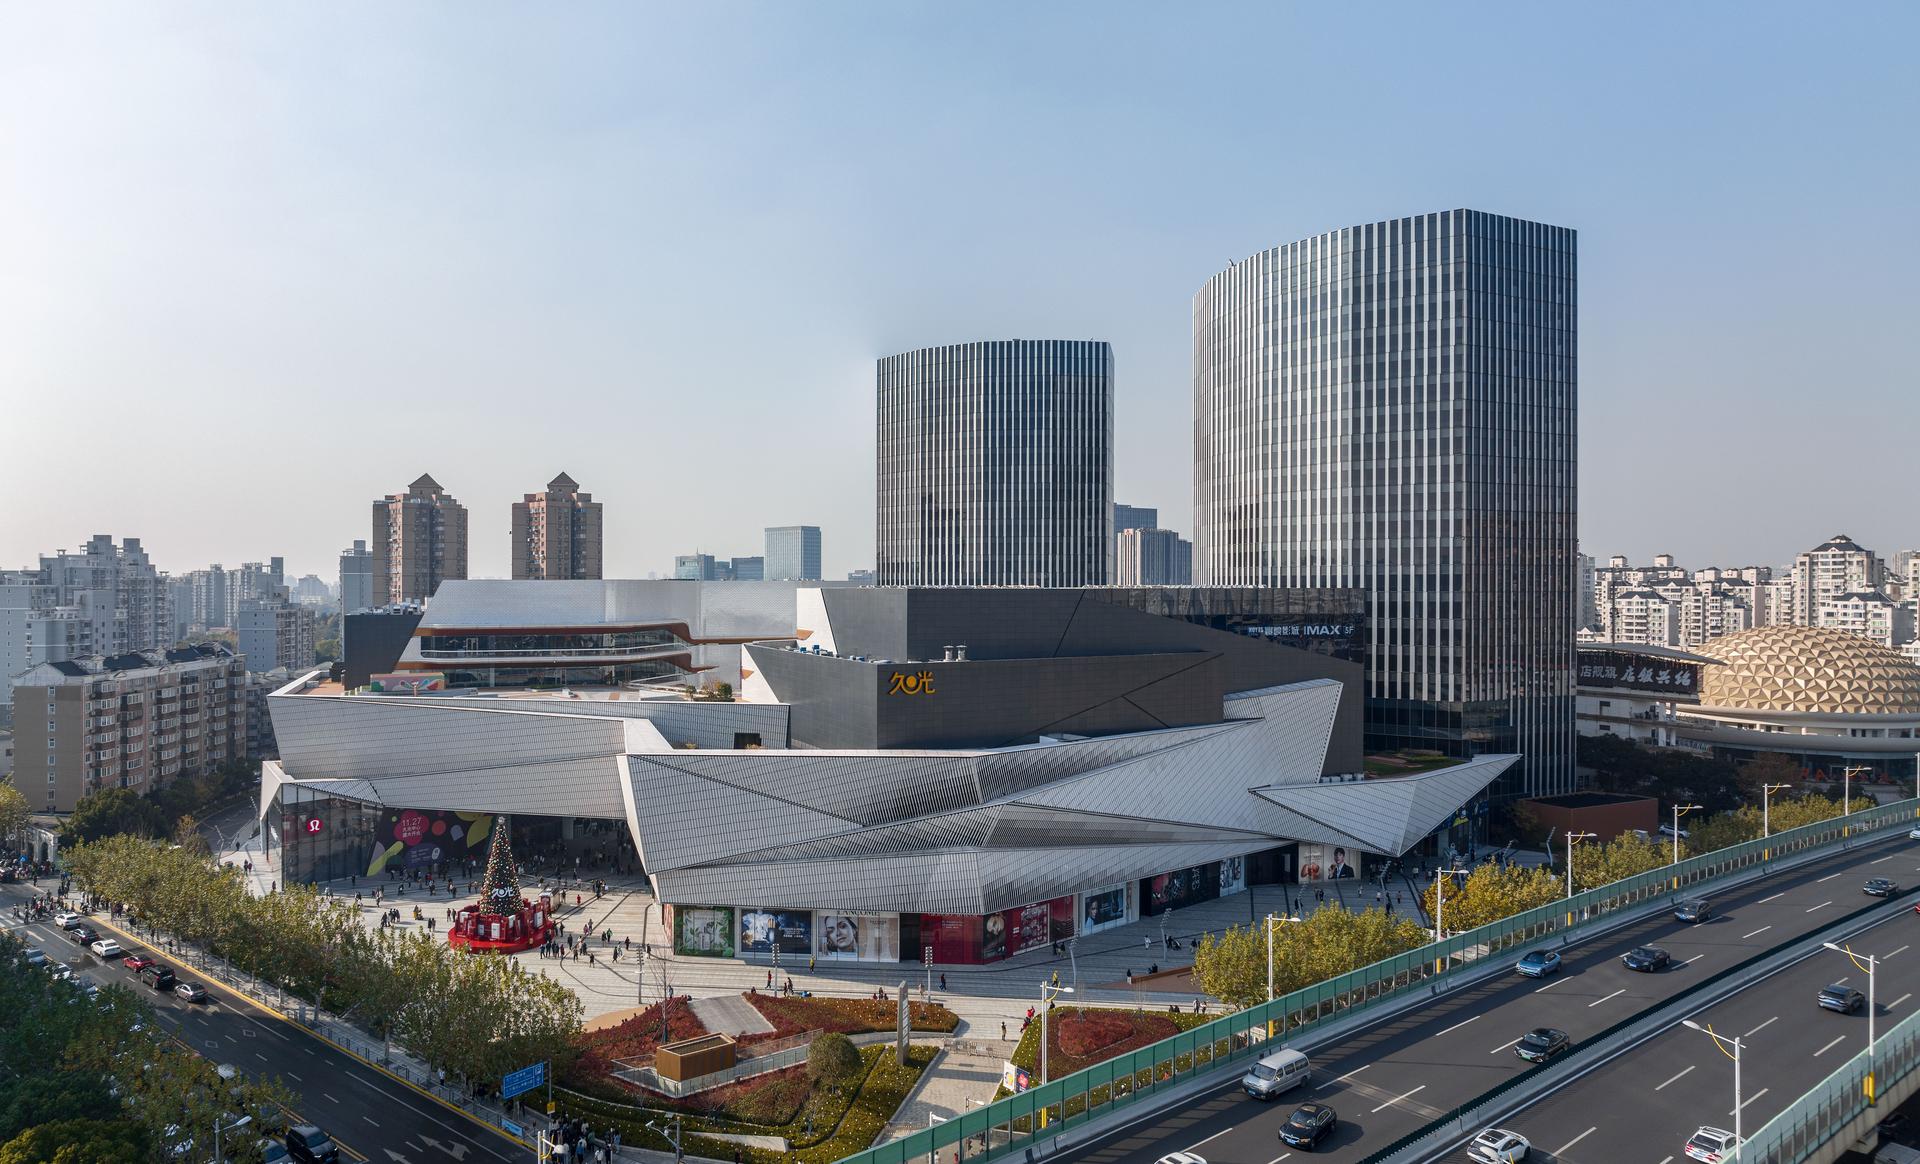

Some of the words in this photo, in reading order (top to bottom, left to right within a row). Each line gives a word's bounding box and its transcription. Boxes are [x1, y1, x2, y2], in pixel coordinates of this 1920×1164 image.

[1303, 625, 1340, 635] IMAX
[889, 671, 936, 696] 久光
[402, 817, 422, 827] 11.27
[491, 886, 514, 900] 久光
